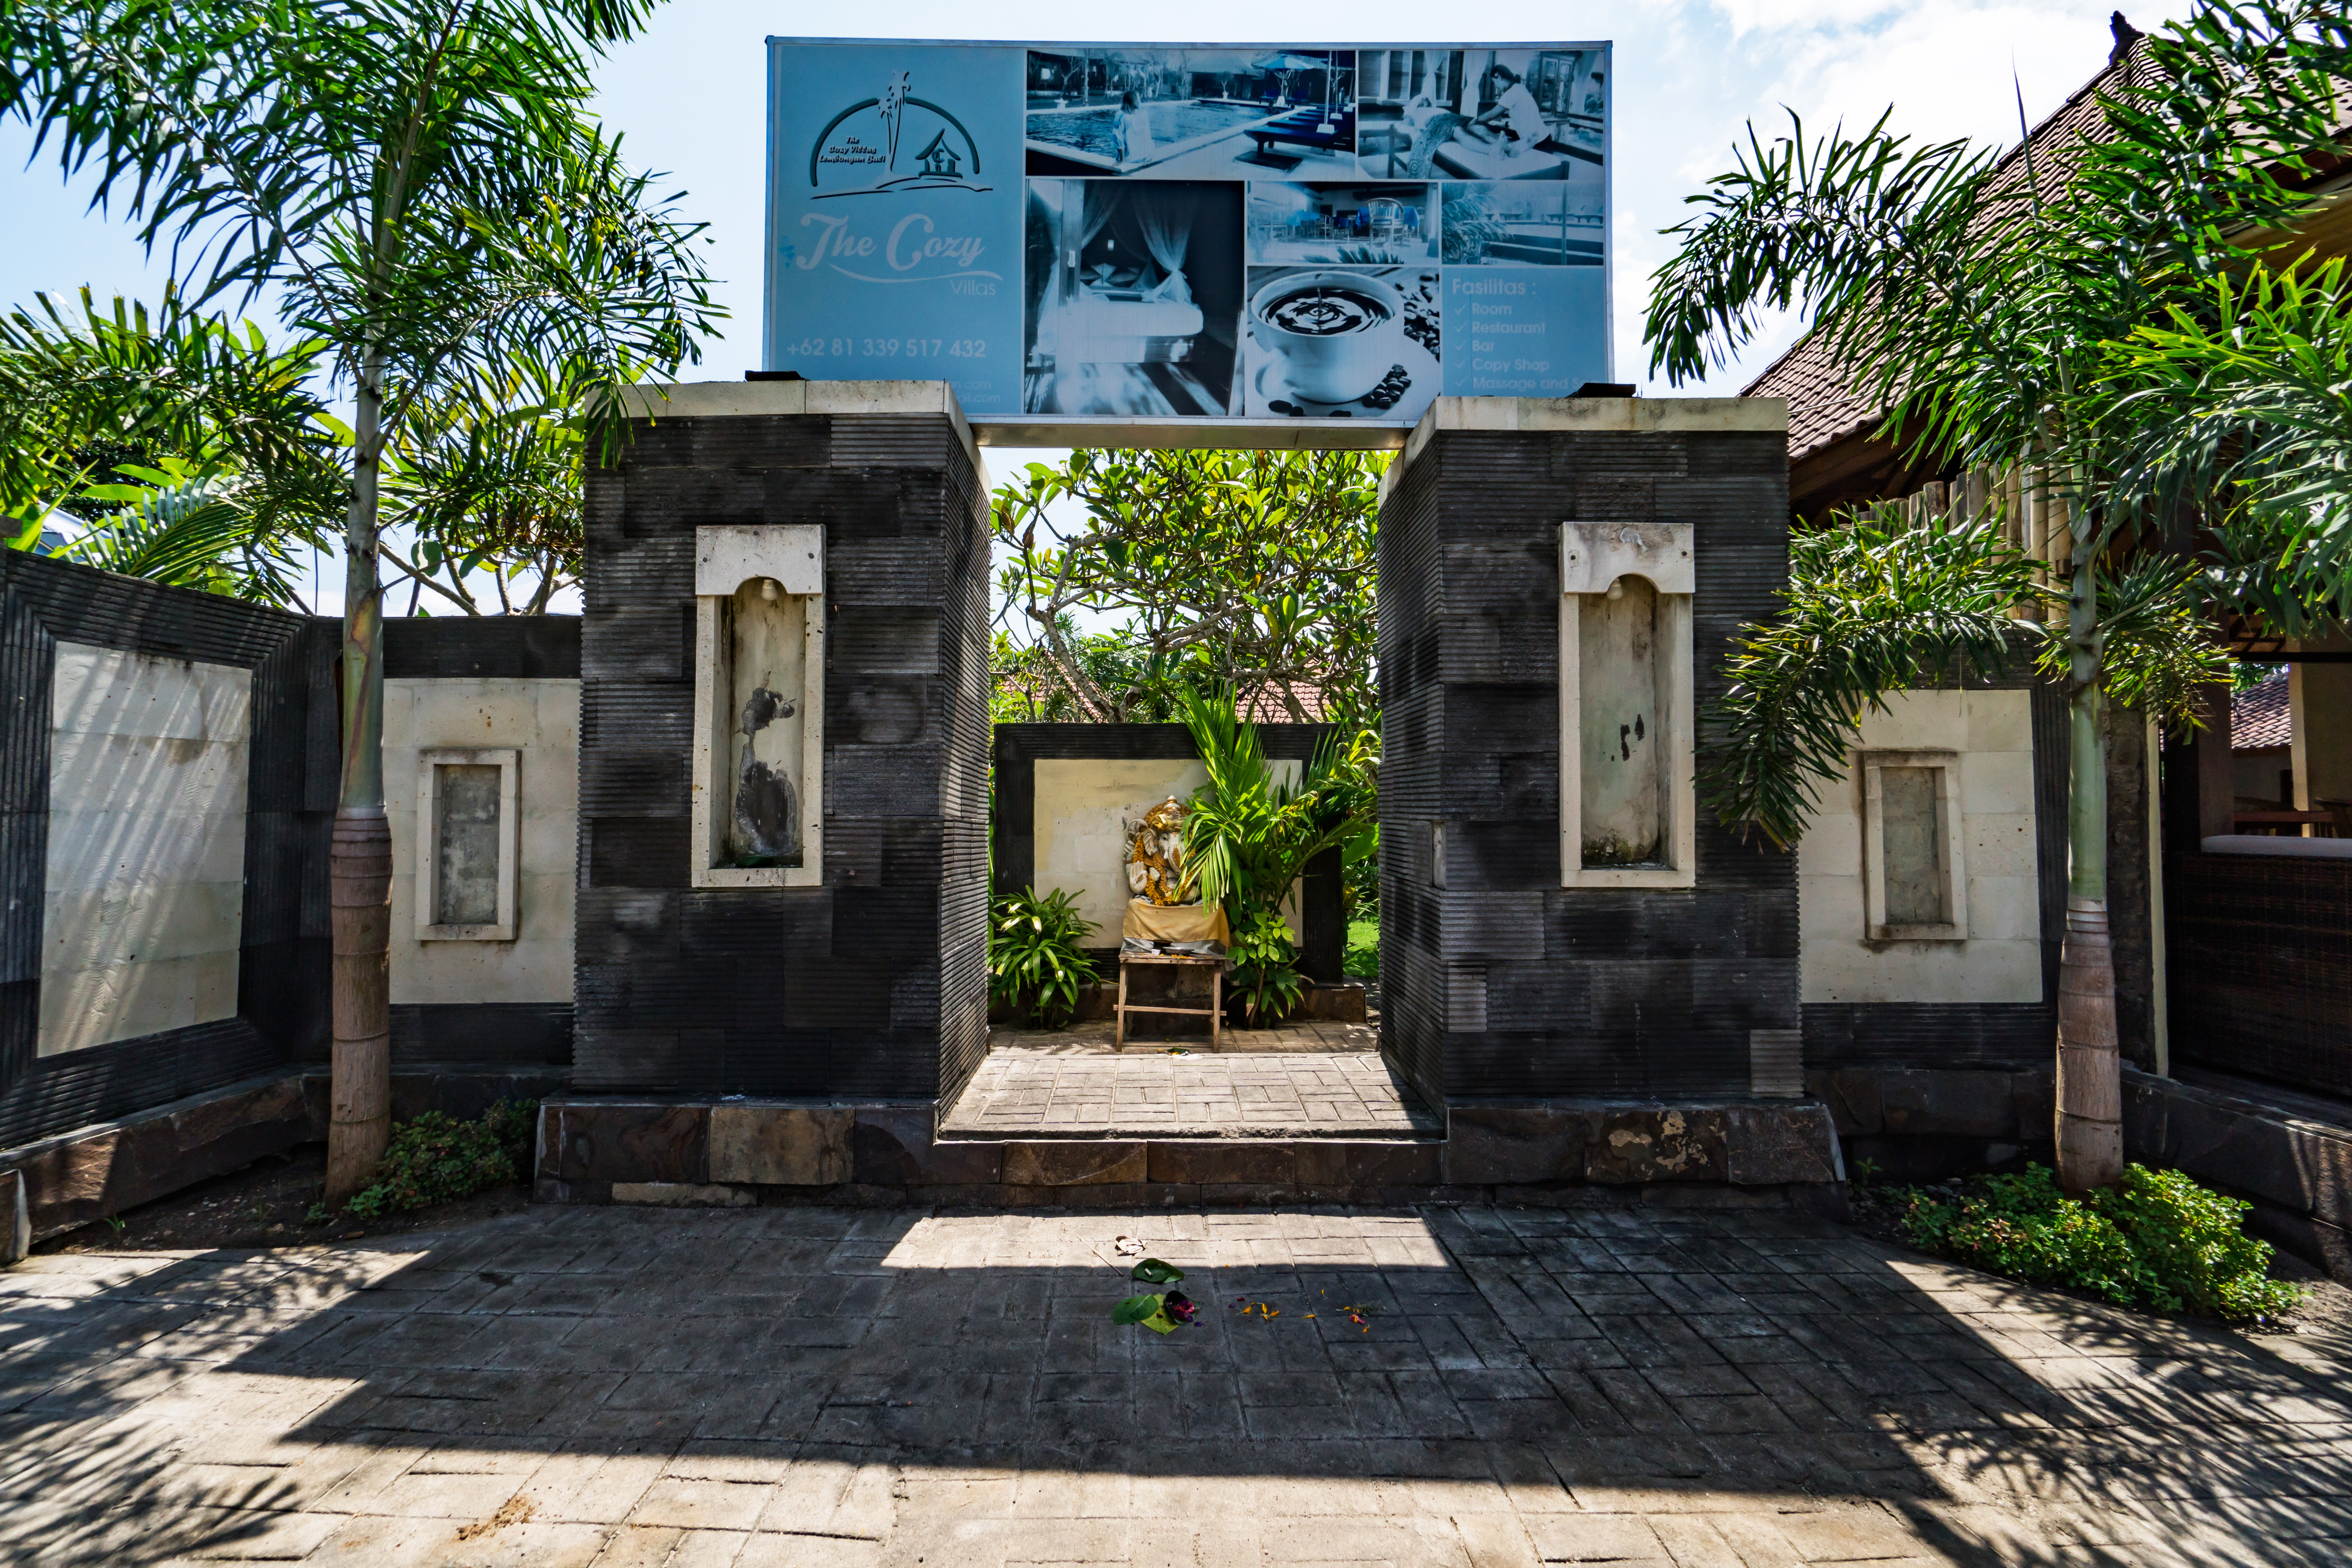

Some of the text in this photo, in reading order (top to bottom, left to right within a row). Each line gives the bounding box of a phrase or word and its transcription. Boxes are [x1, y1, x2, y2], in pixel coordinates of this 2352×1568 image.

[796, 213, 986, 271] The Cozy
[950, 280, 995, 295] Villas
[1452, 278, 1526, 295] Fasilitas
[1472, 303, 1512, 314] Room
[1472, 322, 1546, 333] Restaurant
[787, 339, 986, 357] +62 81 339 517 432
[1473, 341, 1495, 352] Bar
[1515, 359, 1549, 371] Shop
[1473, 377, 1535, 391] Massage
[1541, 378, 1568, 389] and
